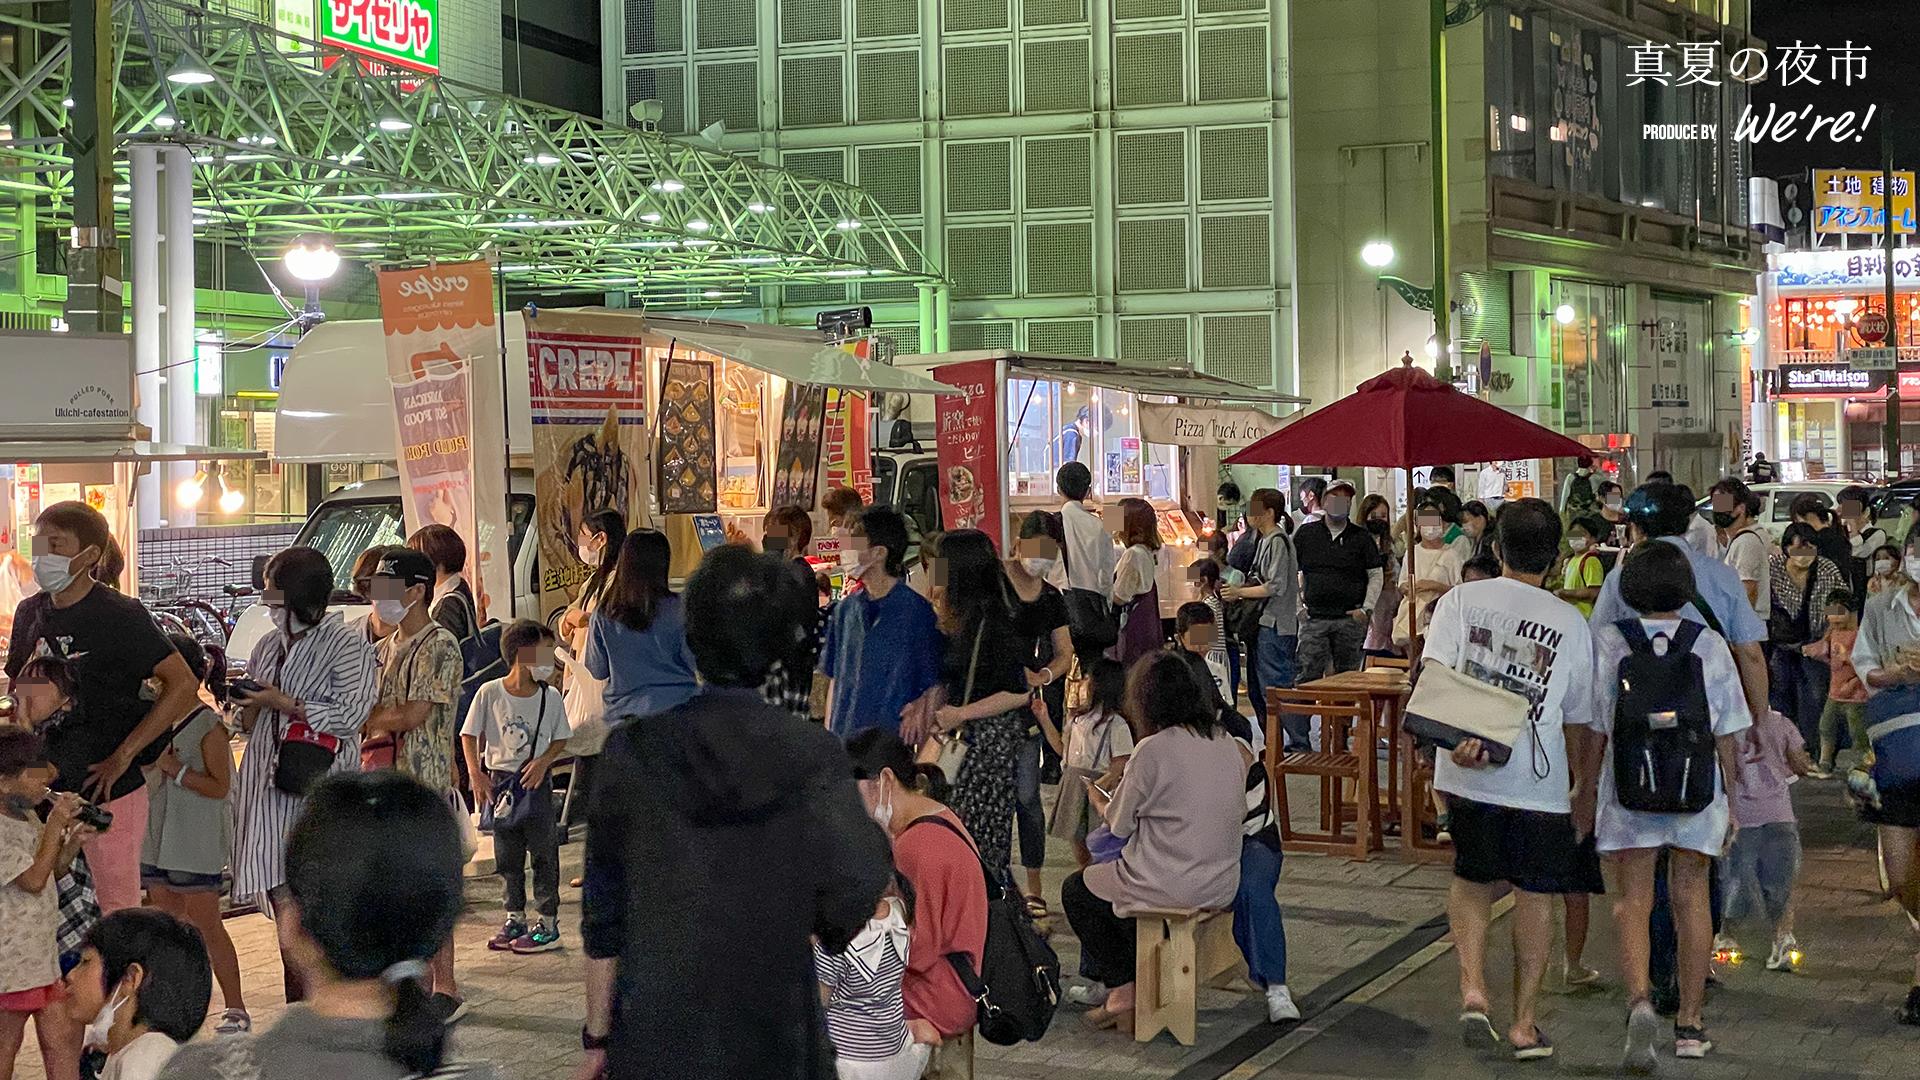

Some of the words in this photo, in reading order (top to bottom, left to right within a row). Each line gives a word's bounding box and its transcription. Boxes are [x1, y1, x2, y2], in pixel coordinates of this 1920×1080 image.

[328, 0, 433, 59] サイゼリヤ
[1827, 175, 1862, 195] 土地
[538, 346, 634, 391] CREPE
[1174, 418, 1204, 438] Pizza
